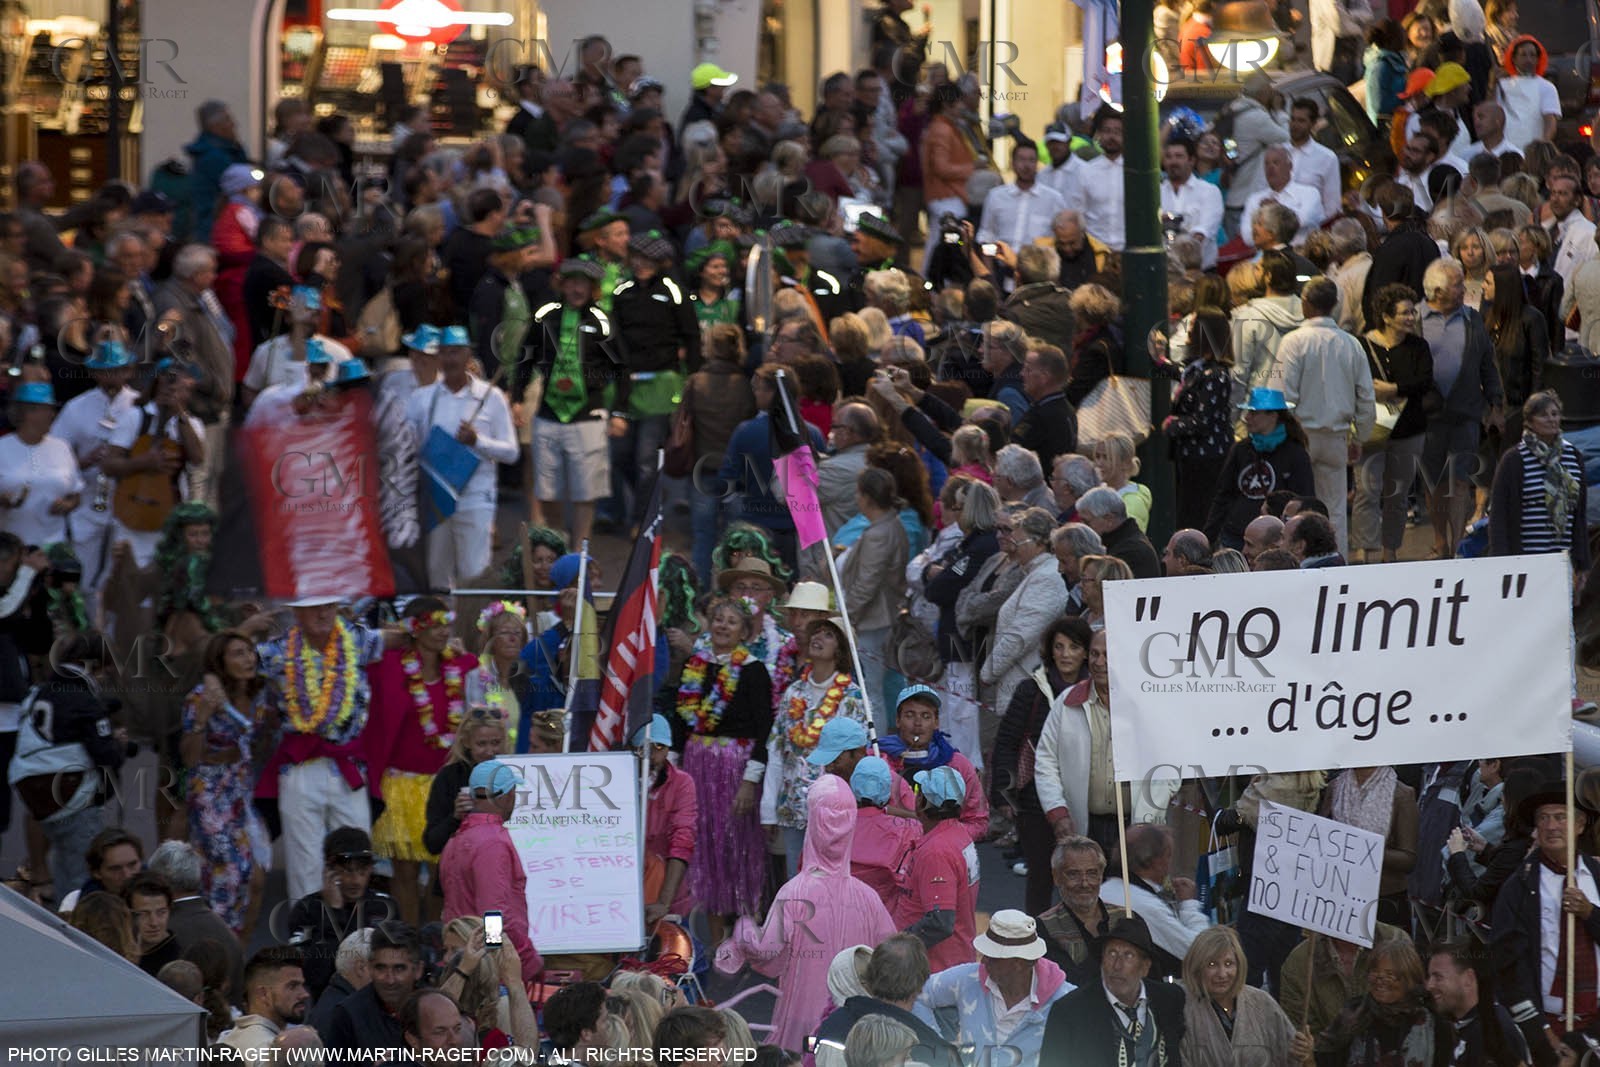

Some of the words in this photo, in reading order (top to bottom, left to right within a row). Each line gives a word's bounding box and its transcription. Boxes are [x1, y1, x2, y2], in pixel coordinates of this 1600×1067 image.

[1187, 606, 1280, 662] no
[1310, 577, 1470, 655] limit
[1267, 680, 1413, 741] d'âge
[1265, 845, 1280, 875] &
[1267, 812, 1379, 873] SEASEX
[526, 856, 564, 873] EST
[574, 854, 635, 871] TEMPS
[548, 876, 585, 889] DE
[530, 900, 630, 935] VIRER
